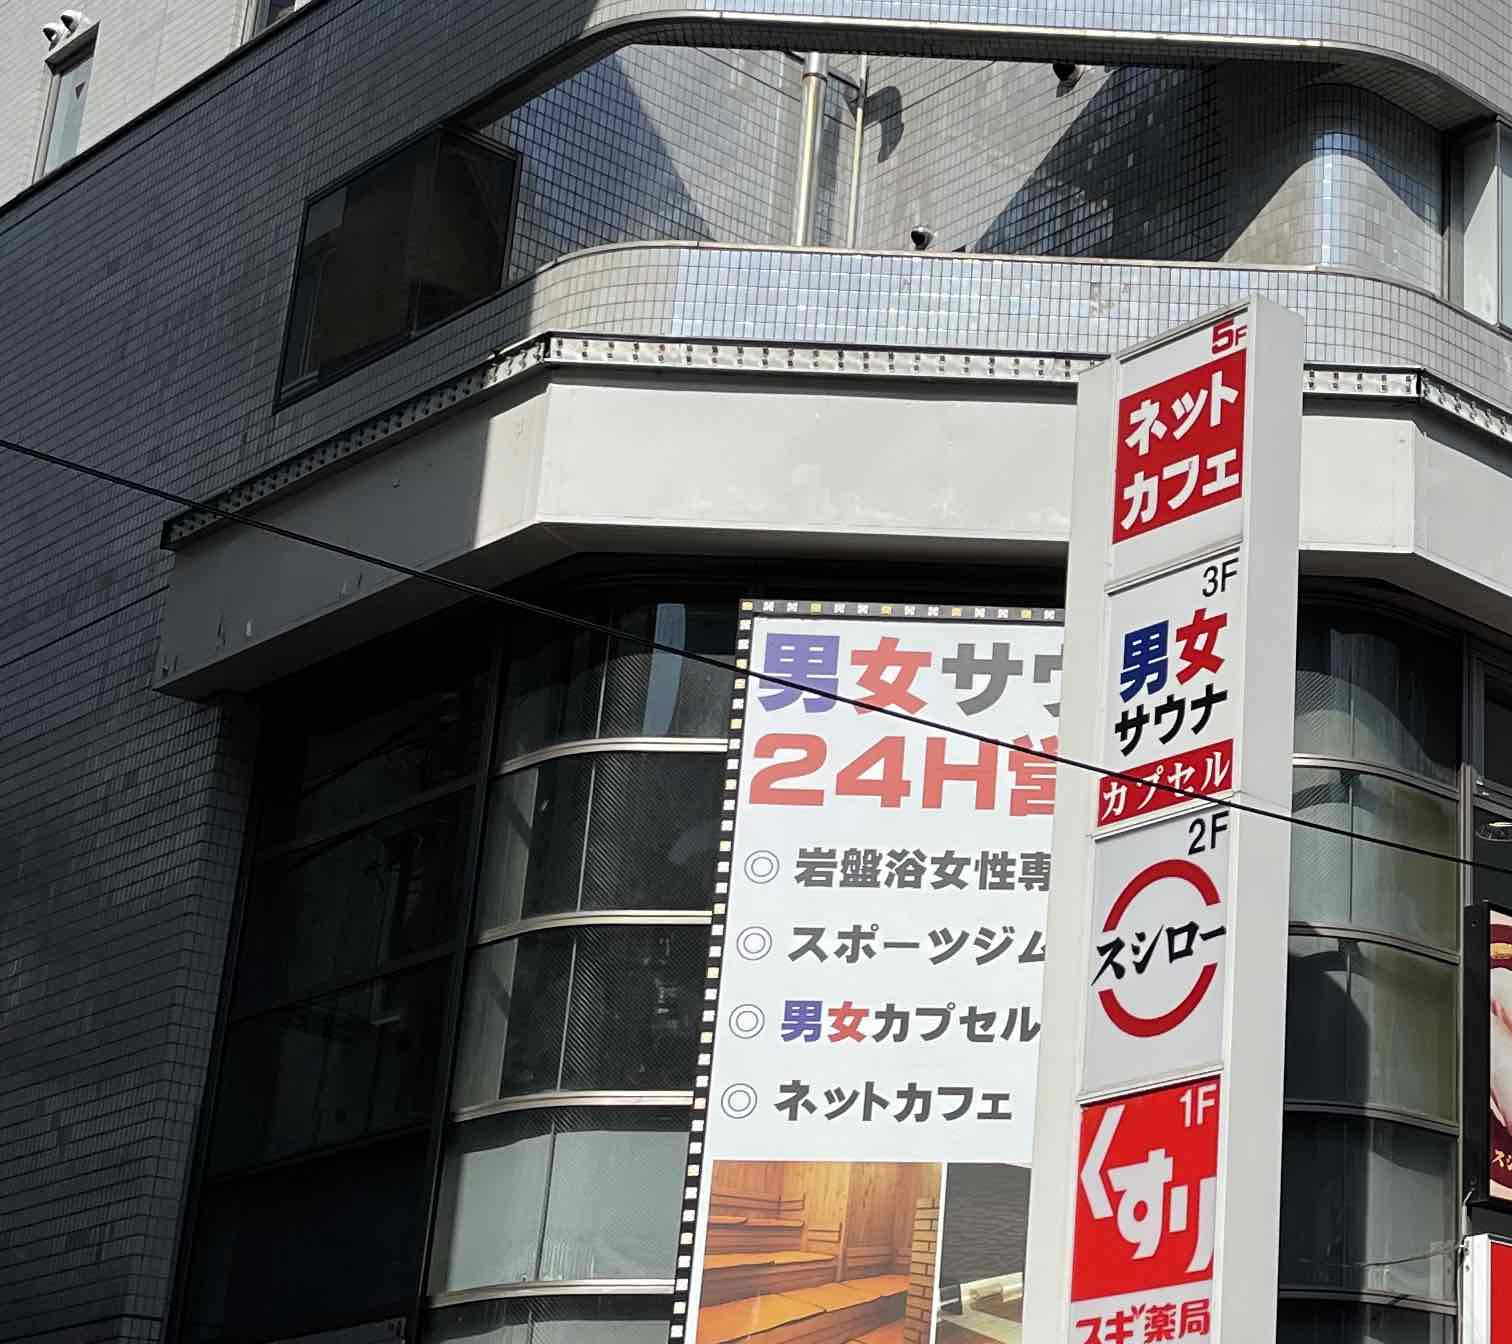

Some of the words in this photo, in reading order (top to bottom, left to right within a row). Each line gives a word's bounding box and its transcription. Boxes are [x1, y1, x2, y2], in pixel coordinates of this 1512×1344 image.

[1210, 319, 1249, 355] 5F
[1124, 370, 1239, 457] ネット
[1120, 447, 1240, 532] カフェ
[1201, 558, 1239, 598] 3F
[1119, 607, 1228, 704] 男女
[1114, 684, 1228, 757] サウナ
[1101, 749, 1231, 823] カプセル
[1187, 810, 1230, 856] 2F
[794, 846, 1051, 891] 岩盤浴女性専
[787, 923, 1047, 966] スポーツジム
[1091, 921, 1227, 986] スシロー
[780, 999, 1042, 1045] 男女カプセル
[774, 1079, 1013, 1123] ネットカフェ
[1178, 1084, 1217, 1128] 1F
[1079, 1104, 1216, 1275] くすり
